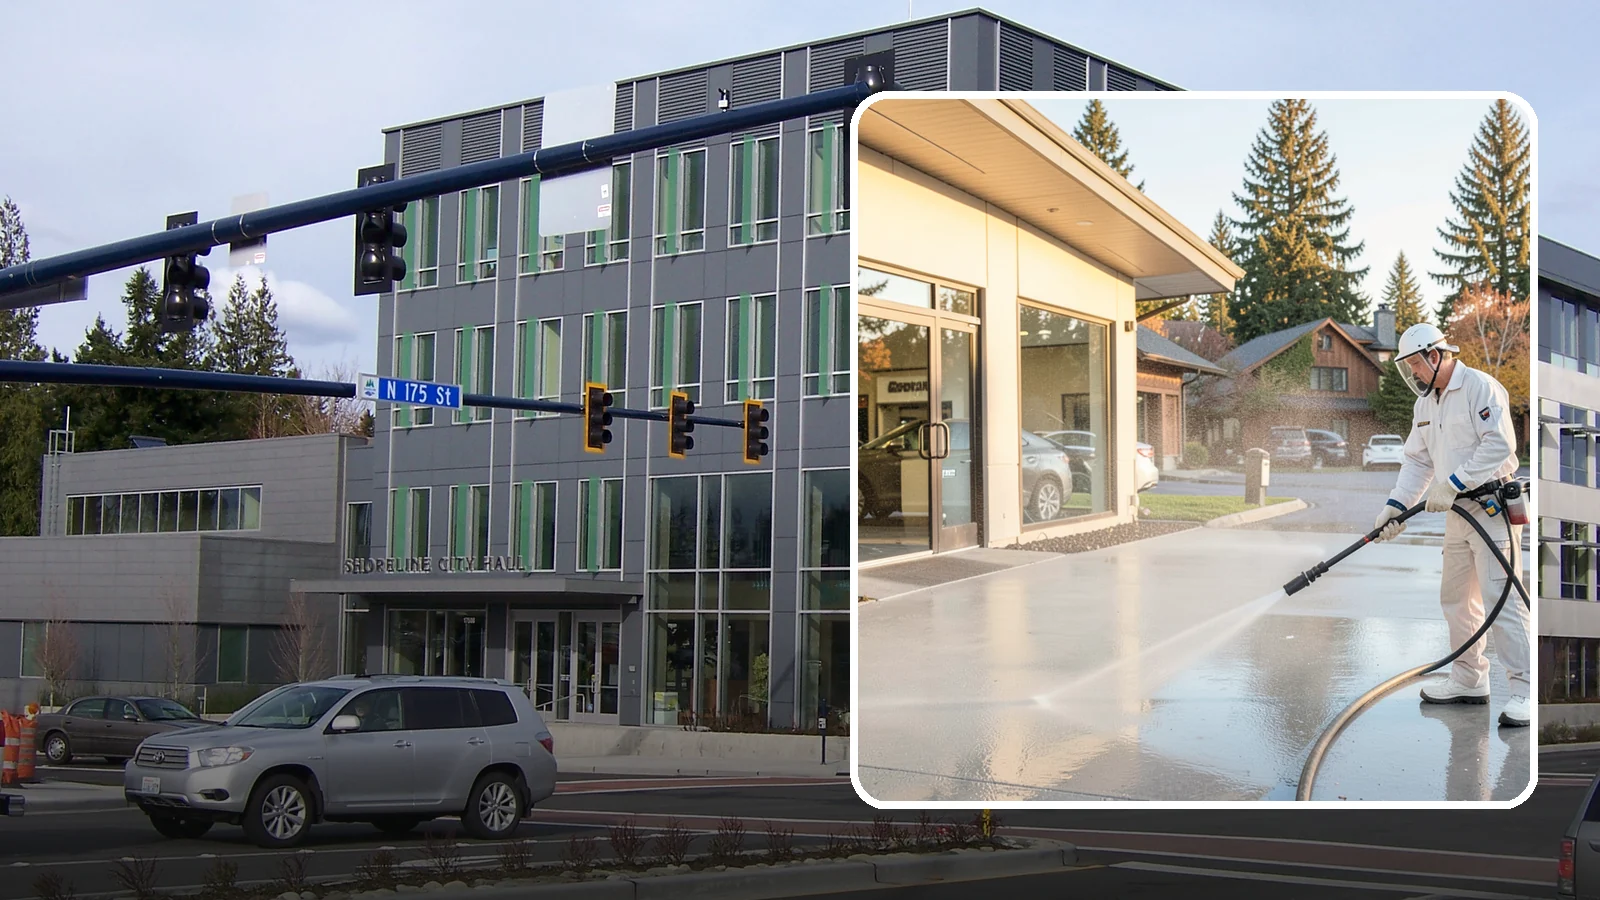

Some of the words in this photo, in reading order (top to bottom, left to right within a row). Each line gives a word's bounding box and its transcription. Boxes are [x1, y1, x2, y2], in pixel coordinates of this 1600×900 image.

[387, 380, 396, 400] N
[405, 382, 427, 403] 175
[436, 386, 451, 406] St
[344, 556, 432, 575] SHORELINE
[438, 556, 475, 573] CITY
[482, 555, 526, 572] HALL
